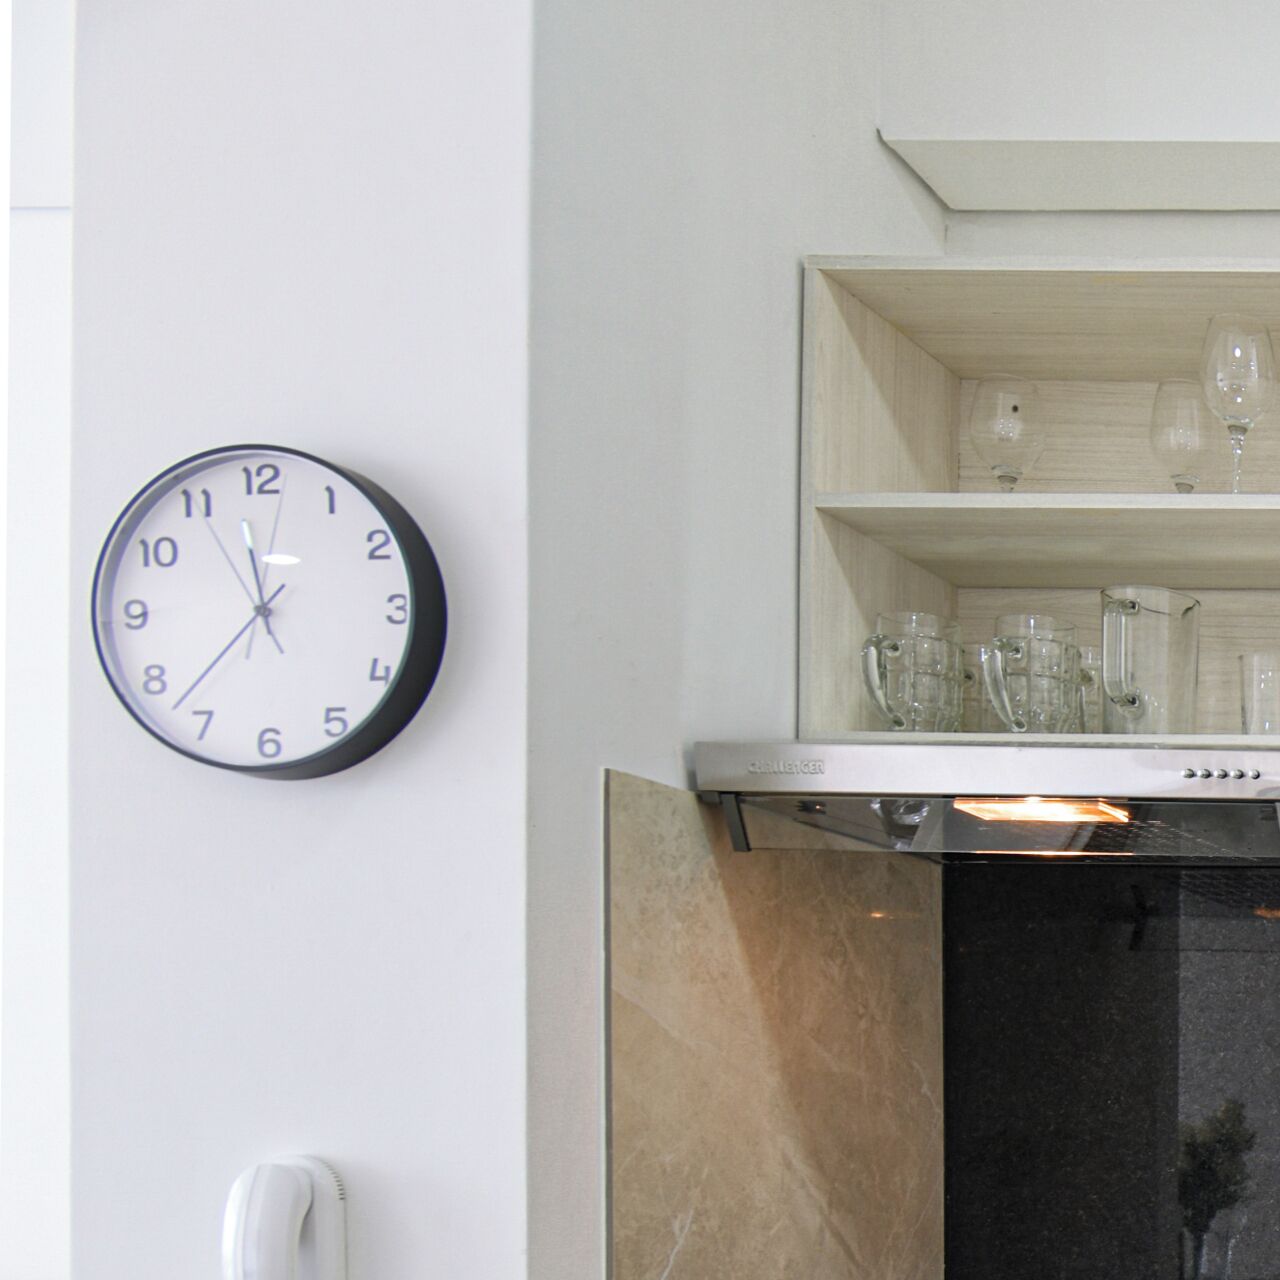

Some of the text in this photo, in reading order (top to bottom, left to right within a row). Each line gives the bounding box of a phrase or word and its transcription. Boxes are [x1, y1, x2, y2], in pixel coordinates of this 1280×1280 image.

[242, 463, 280, 496] 12
[181, 488, 212, 518] 11
[325, 485, 335, 514] 1
[139, 536, 178, 568] 10
[366, 529, 392, 561] 2
[123, 598, 149, 631] 9
[385, 593, 408, 625] 3
[142, 664, 168, 695] 8
[369, 657, 392, 688] 4
[191, 709, 215, 741] 7
[323, 706, 349, 738] 5
[257, 727, 283, 759] 6
